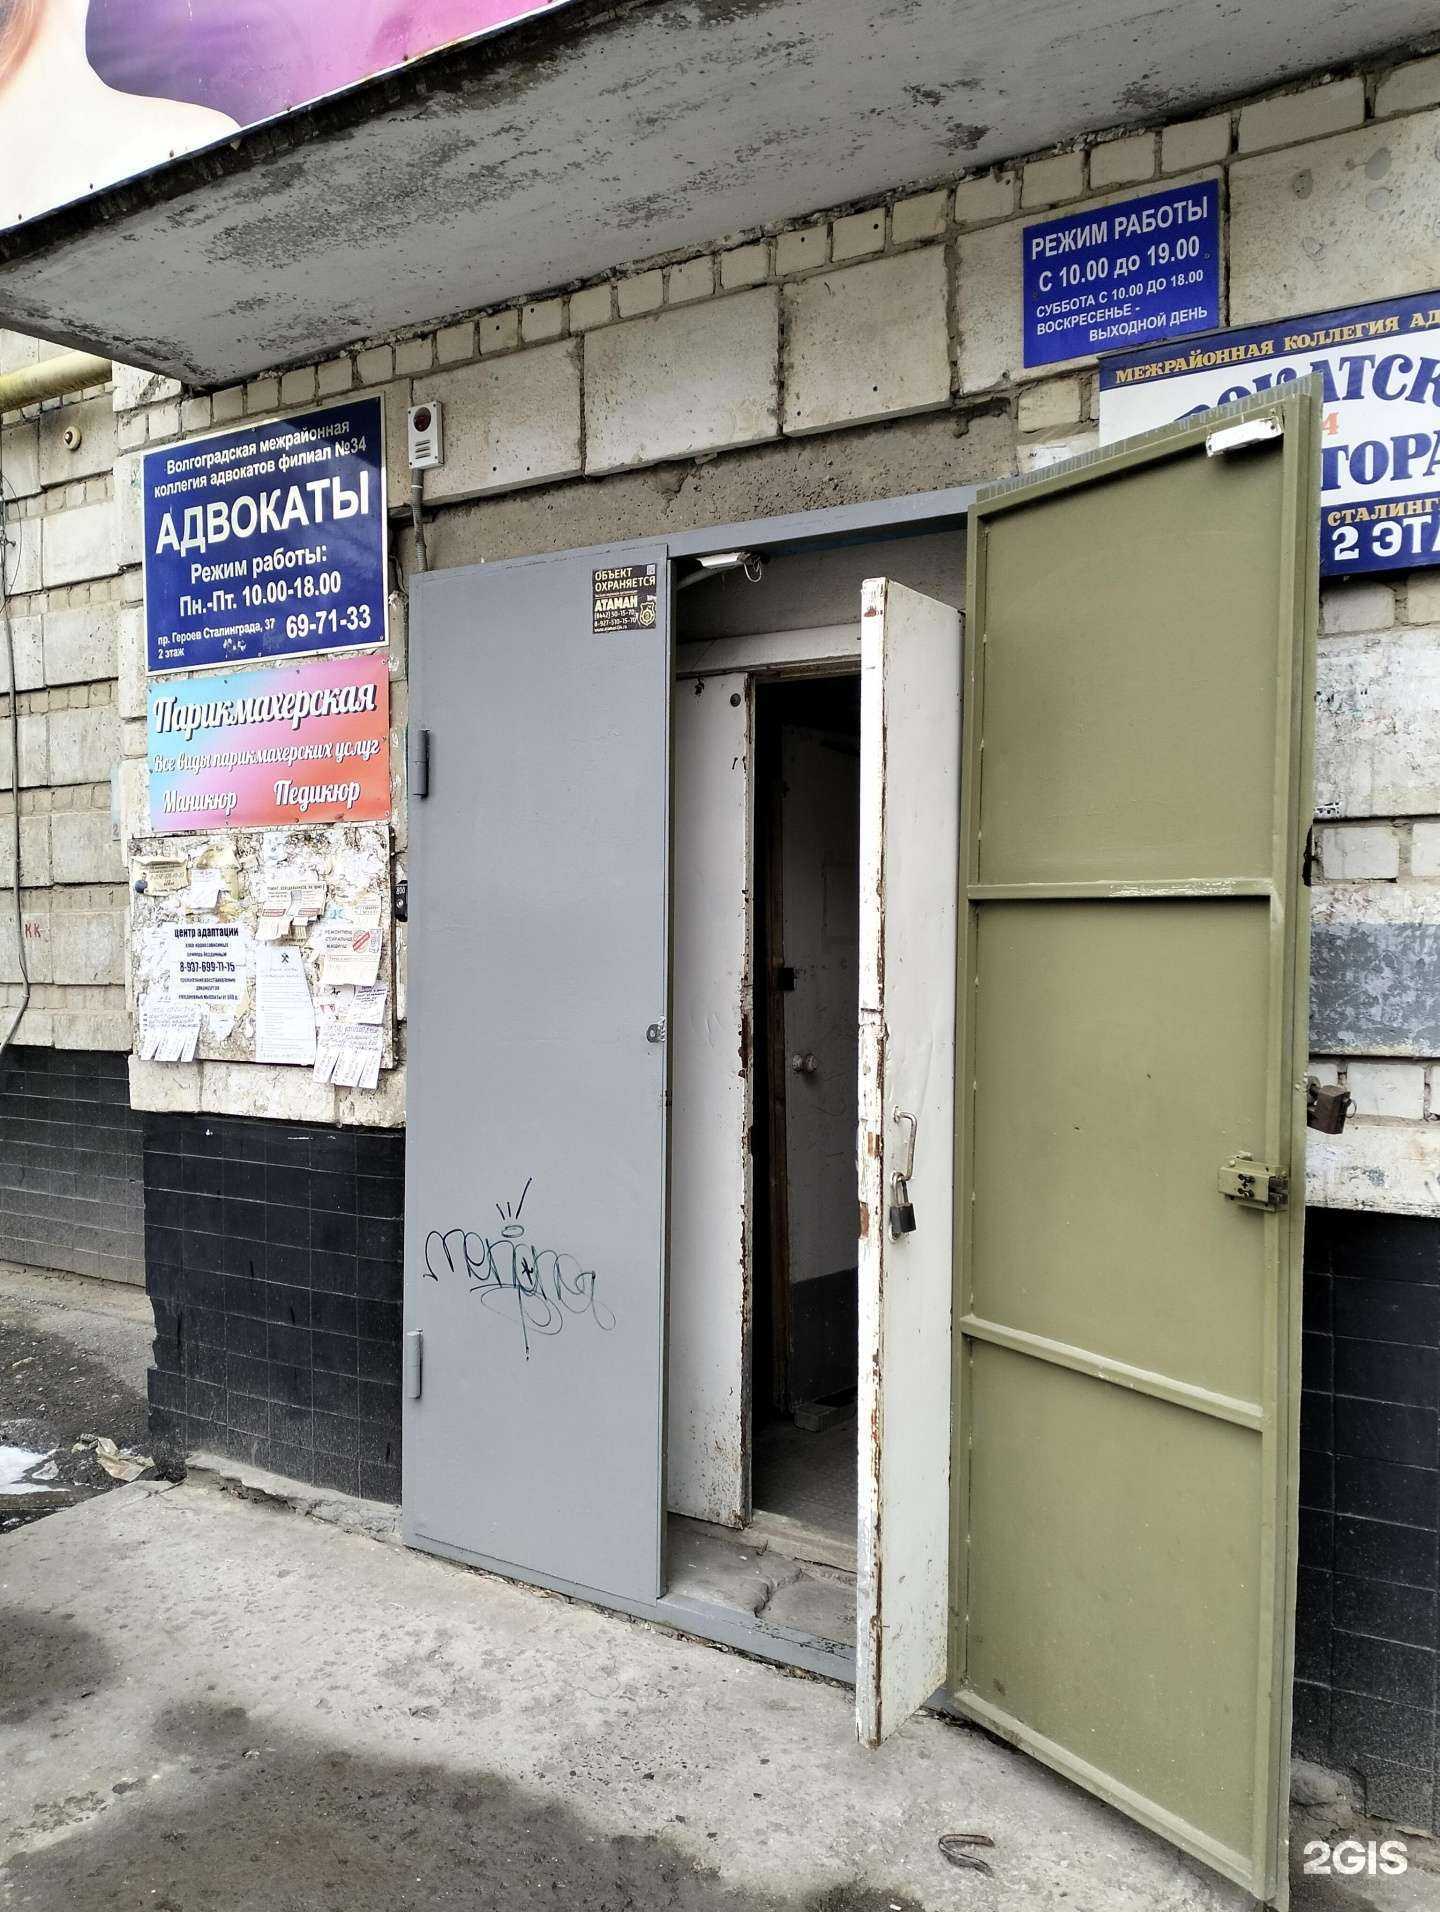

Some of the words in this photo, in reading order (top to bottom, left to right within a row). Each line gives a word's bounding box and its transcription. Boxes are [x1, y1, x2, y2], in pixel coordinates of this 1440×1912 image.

[1032, 221, 1108, 260] РЕЖИМ
[1114, 196, 1208, 240] РАБОТЫ
[1039, 271, 1053, 292] С
[1059, 257, 1109, 287] 10.00
[1147, 235, 1200, 266] 19.00
[1036, 295, 1096, 318] СУББОТА
[1099, 292, 1108, 304] С
[1111, 283, 1144, 301] 10.00
[1146, 278, 1167, 295] ДО
[1170, 269, 1204, 288] 18.00
[1037, 303, 1132, 335] ВОСКРЕСЕНЬЕ
[1089, 312, 1167, 342] ВЫХОДНОЙ
[1170, 306, 1208, 327] ДЕНЬ
[1116, 339, 1274, 385] МЕЖРАЙОННАЯ
[1284, 316, 1400, 352] КОЛЛЕГИЯ
[167, 442, 256, 475] Волгоградская
[260, 420, 350, 453] межрайонная
[154, 475, 207, 498] коллегия
[210, 461, 275, 486] адвокатов
[278, 447, 331, 475] филиал
[335, 436, 367, 456] №34
[155, 470, 369, 557] АДВОКАТЫ
[1332, 525, 1360, 560] 2
[1372, 515, 1440, 557] ЭТ
[191, 558, 247, 584] Режим
[252, 544, 327, 578] работы:
[595, 568, 632, 581] ОБЪЕКТ
[179, 590, 237, 616] Пн.-Пт.
[243, 571, 341, 605] 10.00-18.00
[595, 576, 655, 591] ОХРАНЯЕТСЯ
[286, 604, 371, 638] 69-71-33
[595, 595, 638, 611] АТАМАН
[157, 636, 170, 647] пр.
[172, 630, 201, 644] Героев
[203, 621, 263, 639] Сталинграда,
[265, 618, 275, 630] 37
[158, 649, 163, 659] 2
[165, 647, 184, 659] этаж
[152, 683, 377, 740] Парикмахерская
[154, 755, 176, 773] Все
[178, 752, 212, 775] виды
[213, 742, 332, 771] парикмахерских
[335, 738, 380, 763] услуг
[162, 790, 238, 816] Маникюр
[274, 779, 361, 812] Педикюр
[174, 928, 196, 939] центр
[197, 927, 239, 938] адаптации
